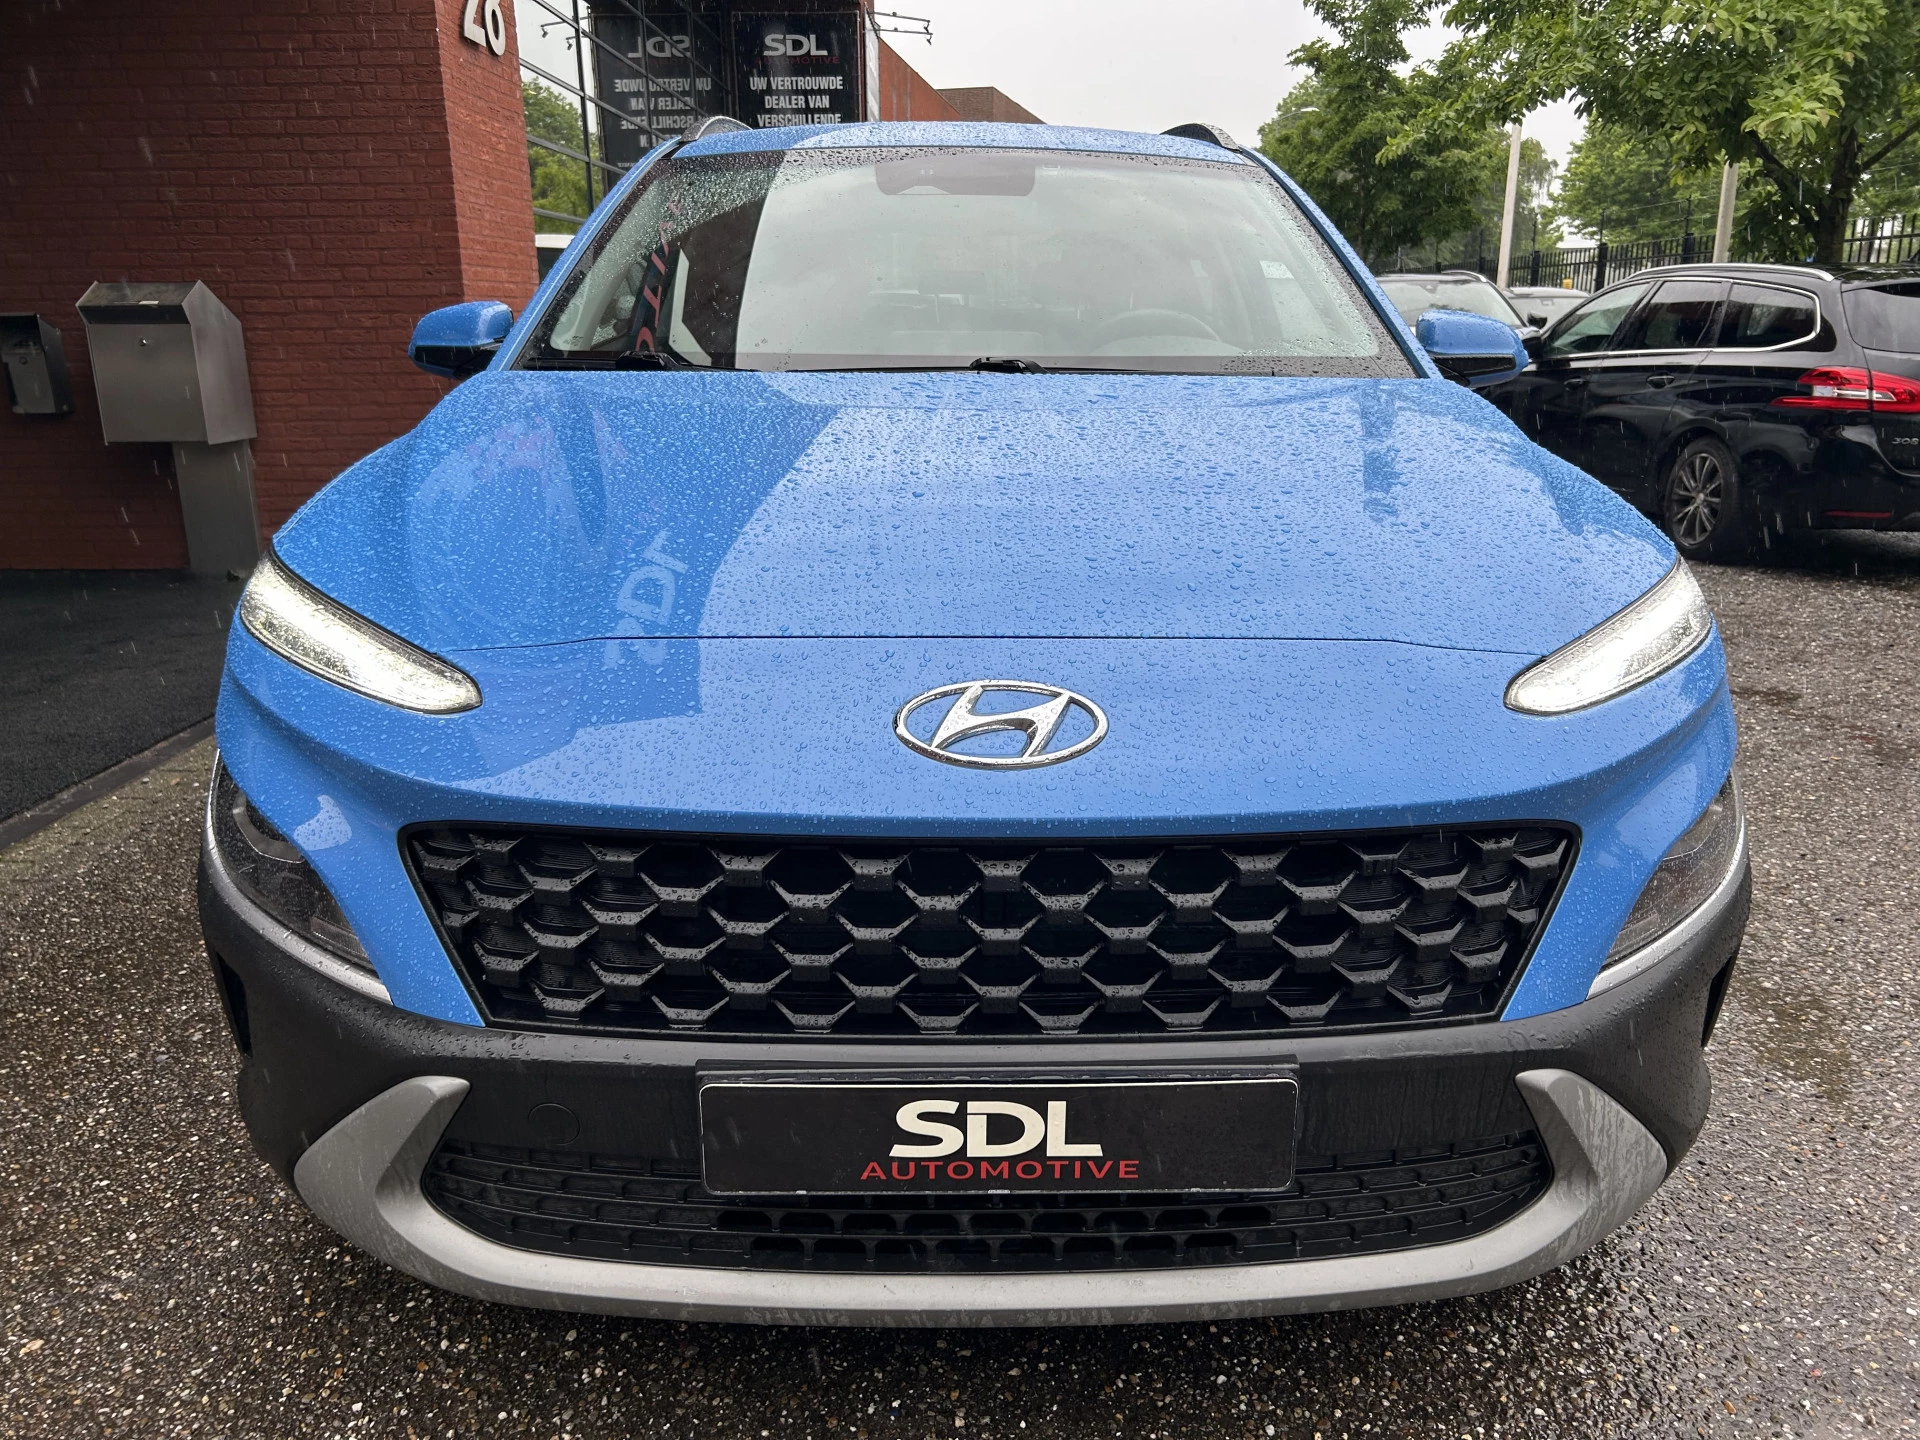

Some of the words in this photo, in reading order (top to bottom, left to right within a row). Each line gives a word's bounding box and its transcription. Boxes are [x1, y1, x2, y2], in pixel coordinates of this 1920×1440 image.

[763, 33, 829, 56] SDL
[749, 77, 768, 91] UW
[770, 76, 844, 90] VERTROUWDE
[764, 95, 806, 109] DEALER
[808, 95, 830, 109] VAN
[757, 113, 842, 128] VERSCHILLENDE
[888, 1099, 1104, 1158] SDL
[860, 1160, 1140, 1180] AUTOMOTIVE
